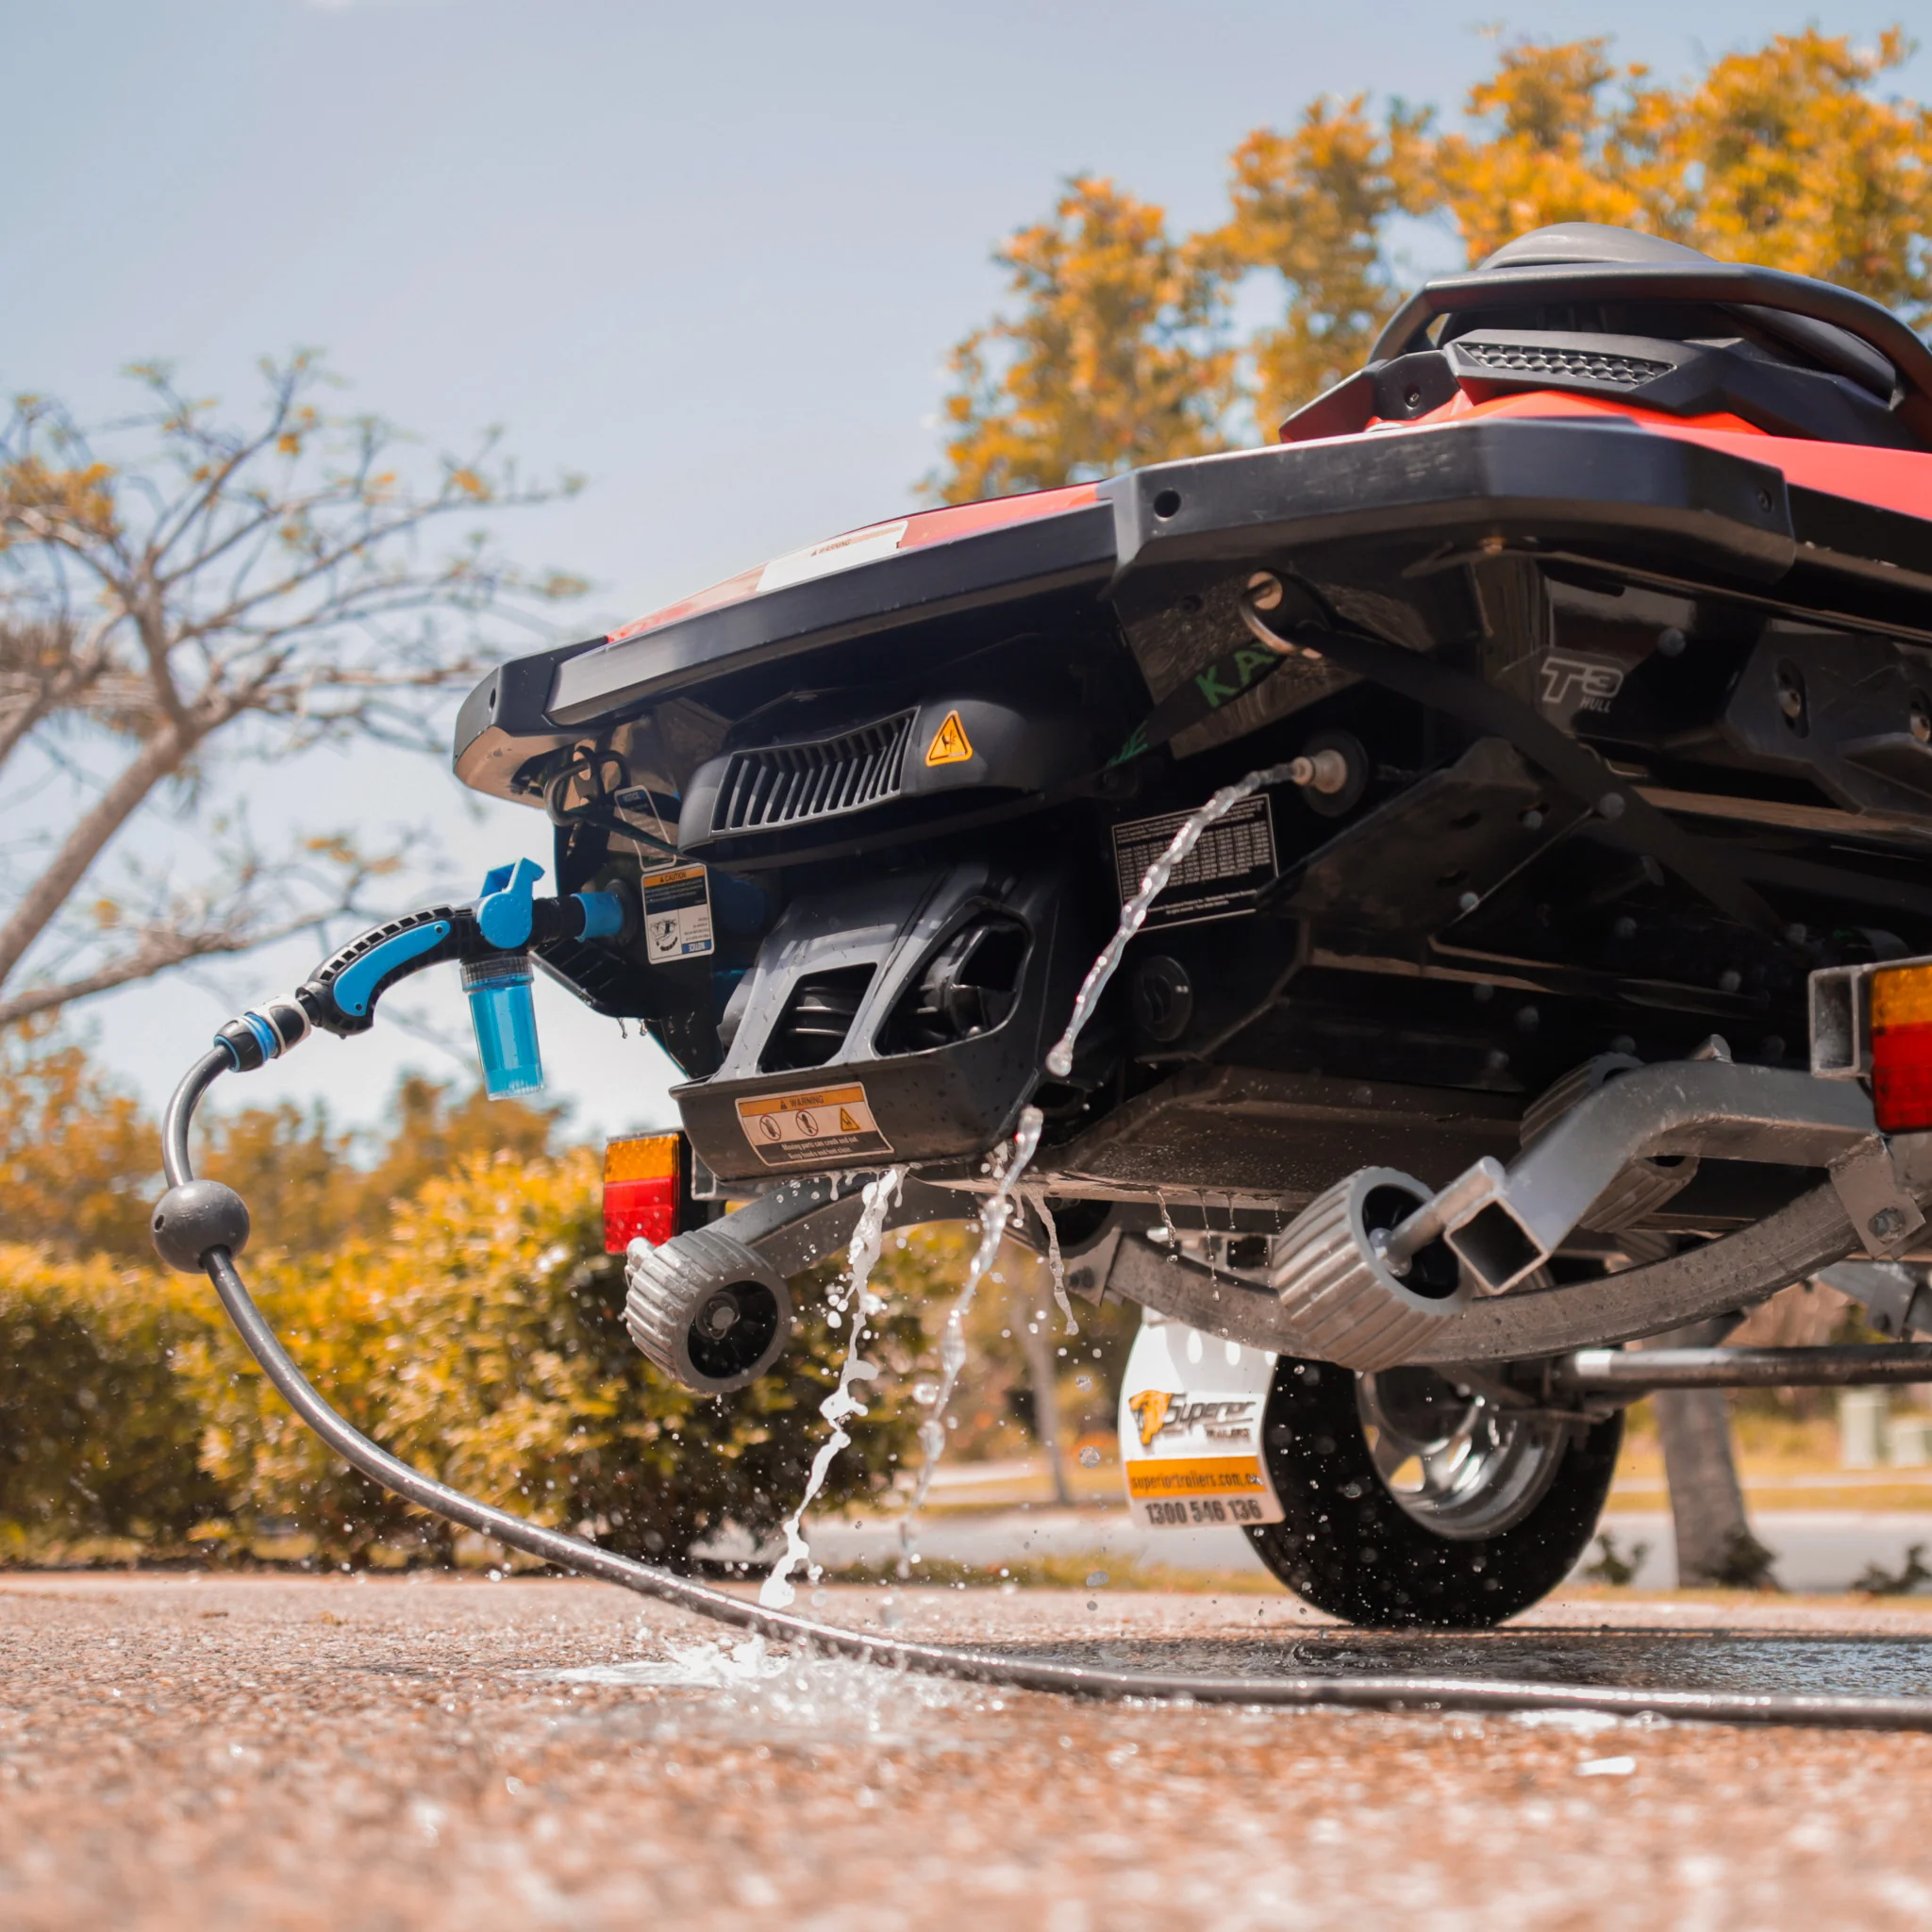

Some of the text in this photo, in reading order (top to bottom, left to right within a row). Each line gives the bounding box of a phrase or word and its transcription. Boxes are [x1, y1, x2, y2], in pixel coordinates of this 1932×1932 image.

[819, 539, 852, 554] WARNING
[1541, 657, 1624, 704] T3
[1580, 696, 1612, 714] HULL
[664, 873, 687, 882] CAUTION
[790, 1094, 824, 1107] WARNING
[1145, 1498, 1263, 1525] 1300 546 136
